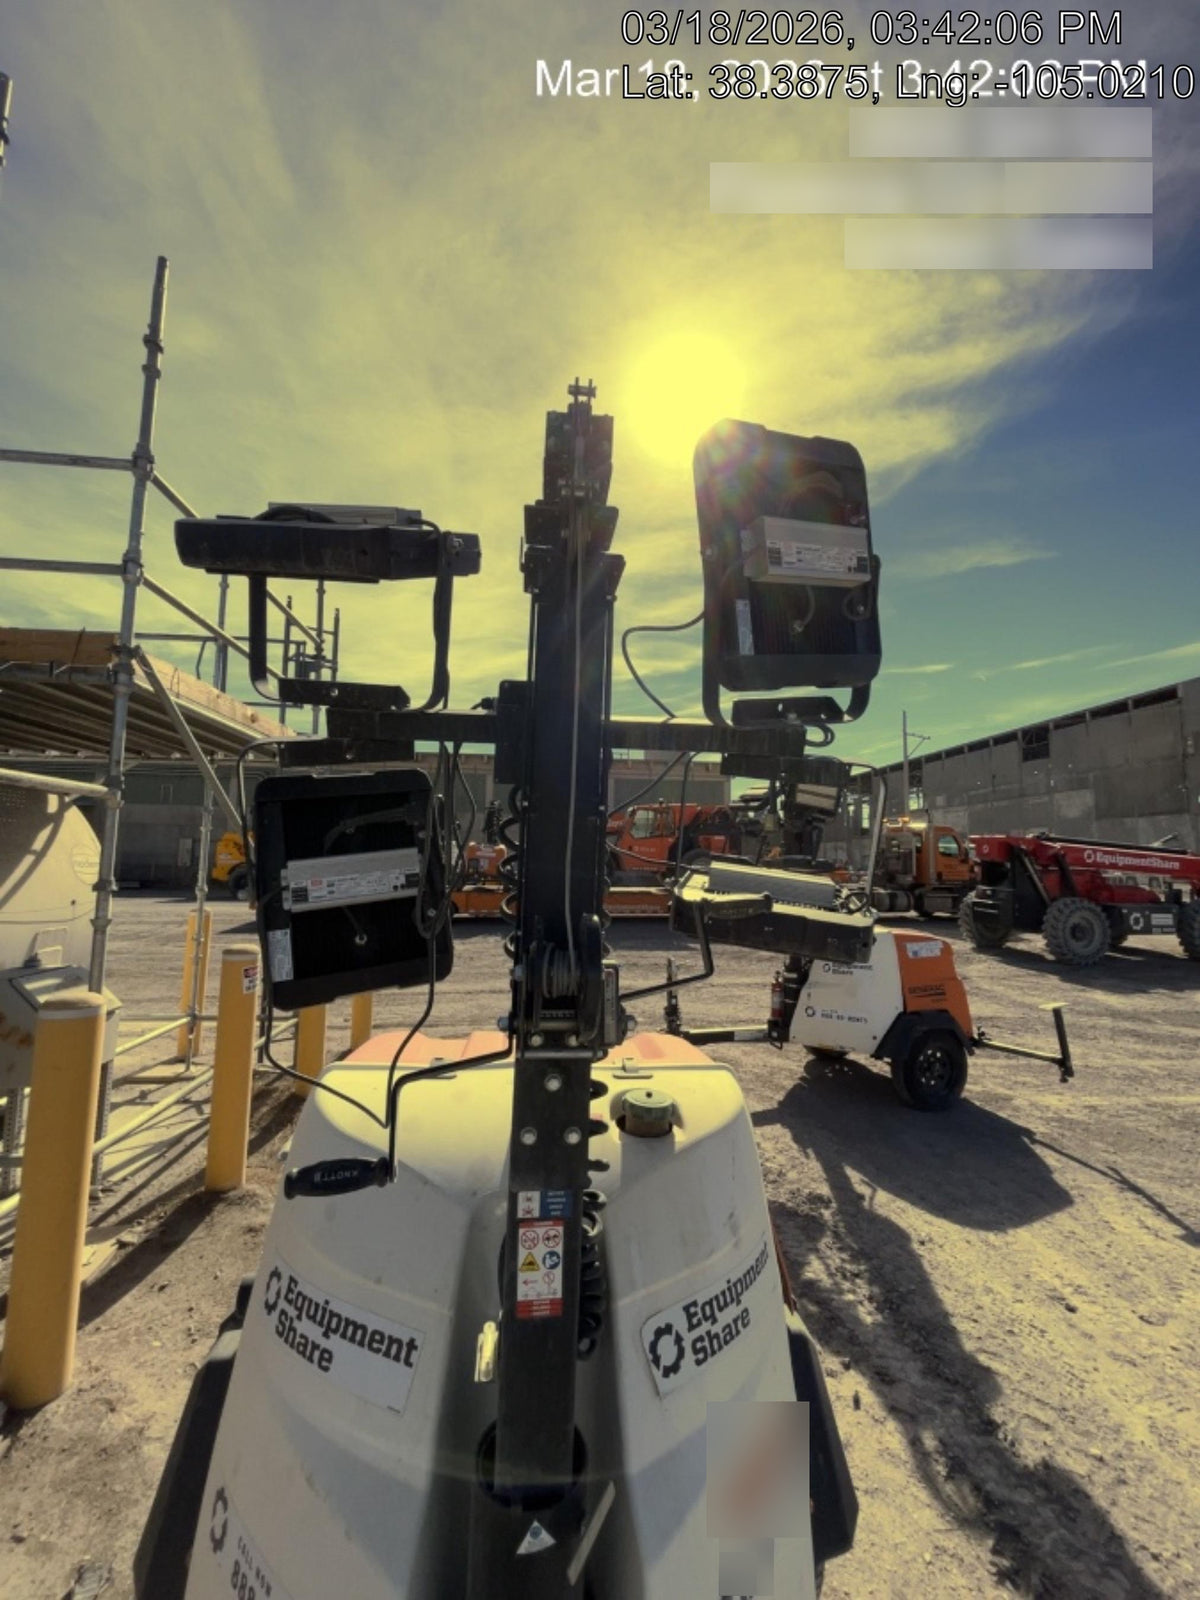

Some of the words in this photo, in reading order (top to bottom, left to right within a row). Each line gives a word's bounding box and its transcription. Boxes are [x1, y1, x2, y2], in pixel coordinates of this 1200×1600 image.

[1096, 851, 1180, 869] EquipmentShare
[682, 1241, 769, 1333] Equipment
[275, 1308, 334, 1373] Share
[283, 1275, 418, 1369] Equipment
[691, 1306, 751, 1367] Share
